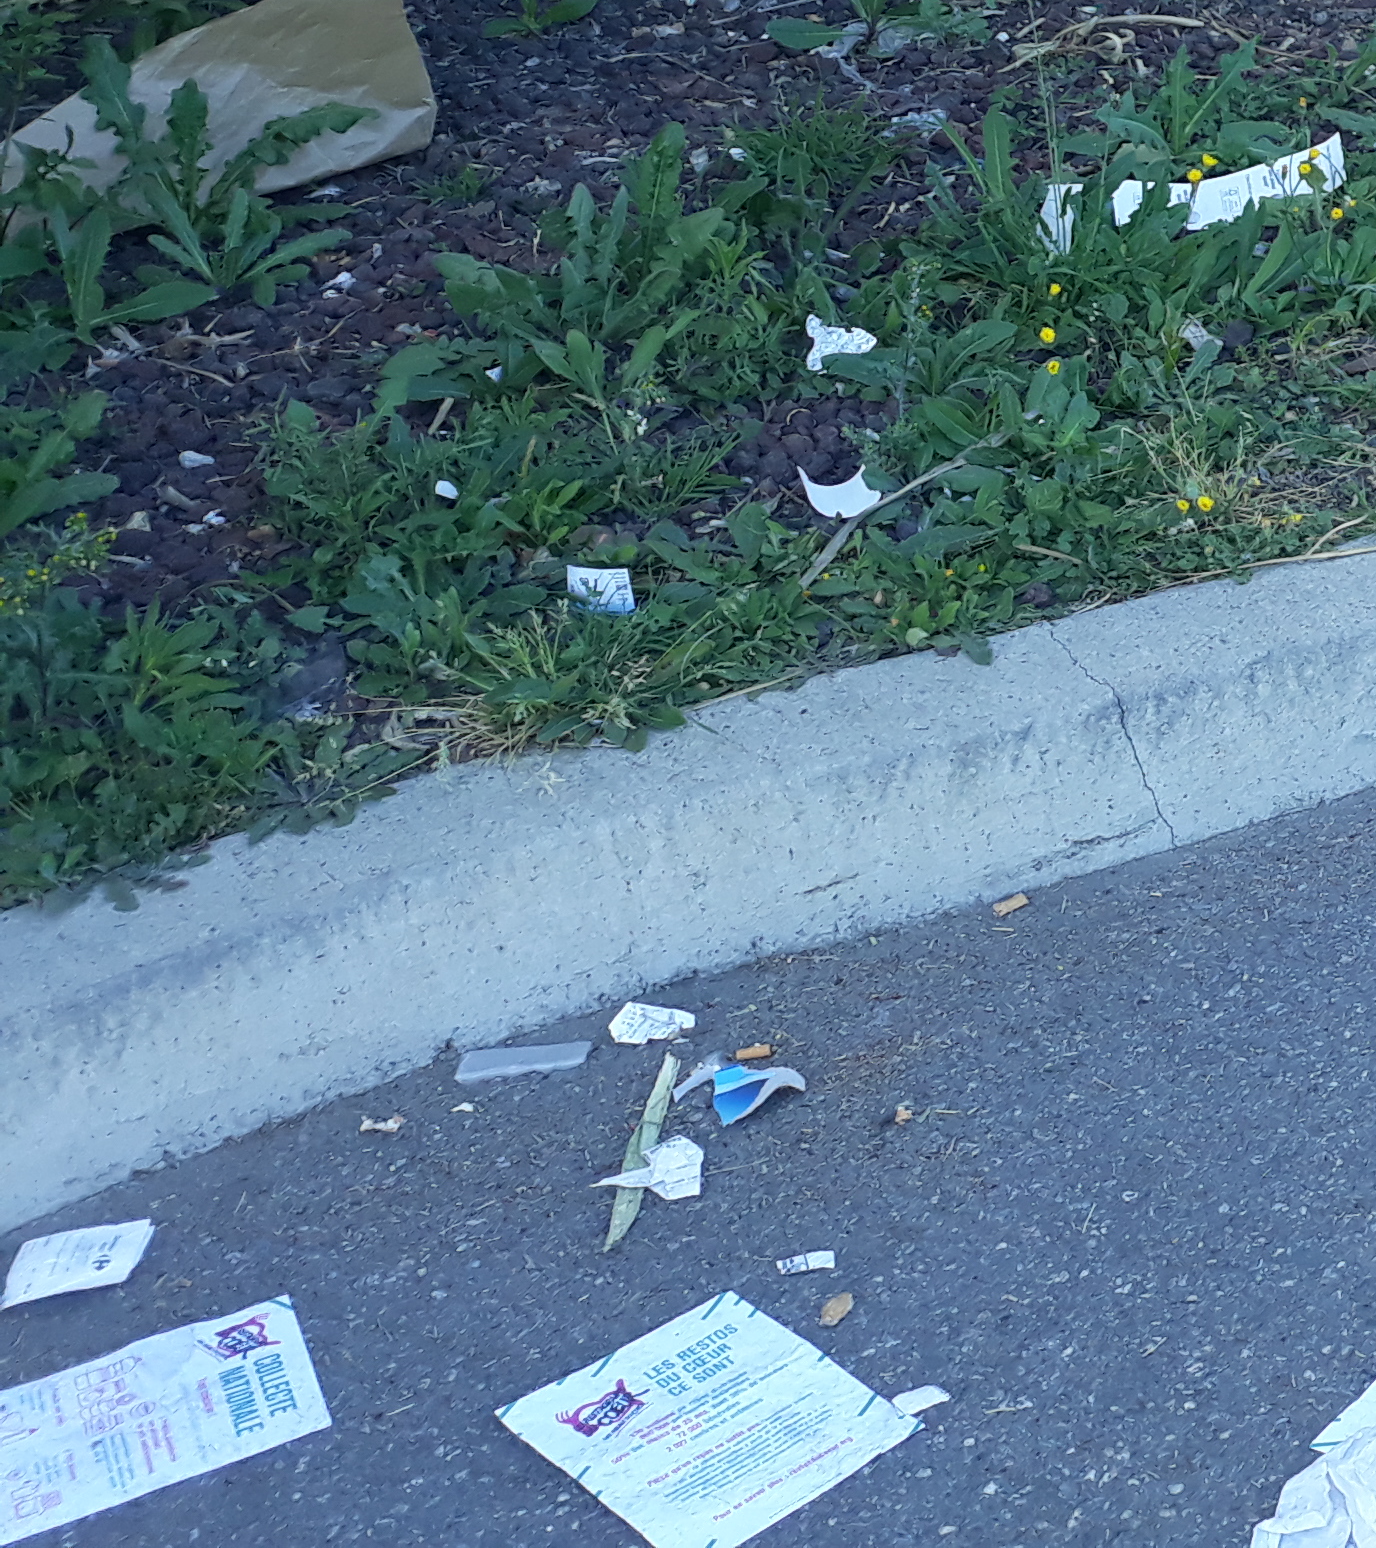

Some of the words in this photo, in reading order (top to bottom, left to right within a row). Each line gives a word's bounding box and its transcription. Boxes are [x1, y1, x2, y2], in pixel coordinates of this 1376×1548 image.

[643, 1359, 676, 1380] LES
[675, 1323, 739, 1362] RESTOS
[655, 1374, 682, 1389] DU
[681, 1342, 733, 1374] CŒUR
[667, 1381, 693, 1397] CE
[692, 1355, 736, 1384] SONT
[218, 1365, 265, 1438] NATIONALE
[253, 1352, 298, 1417] COLLECTE
